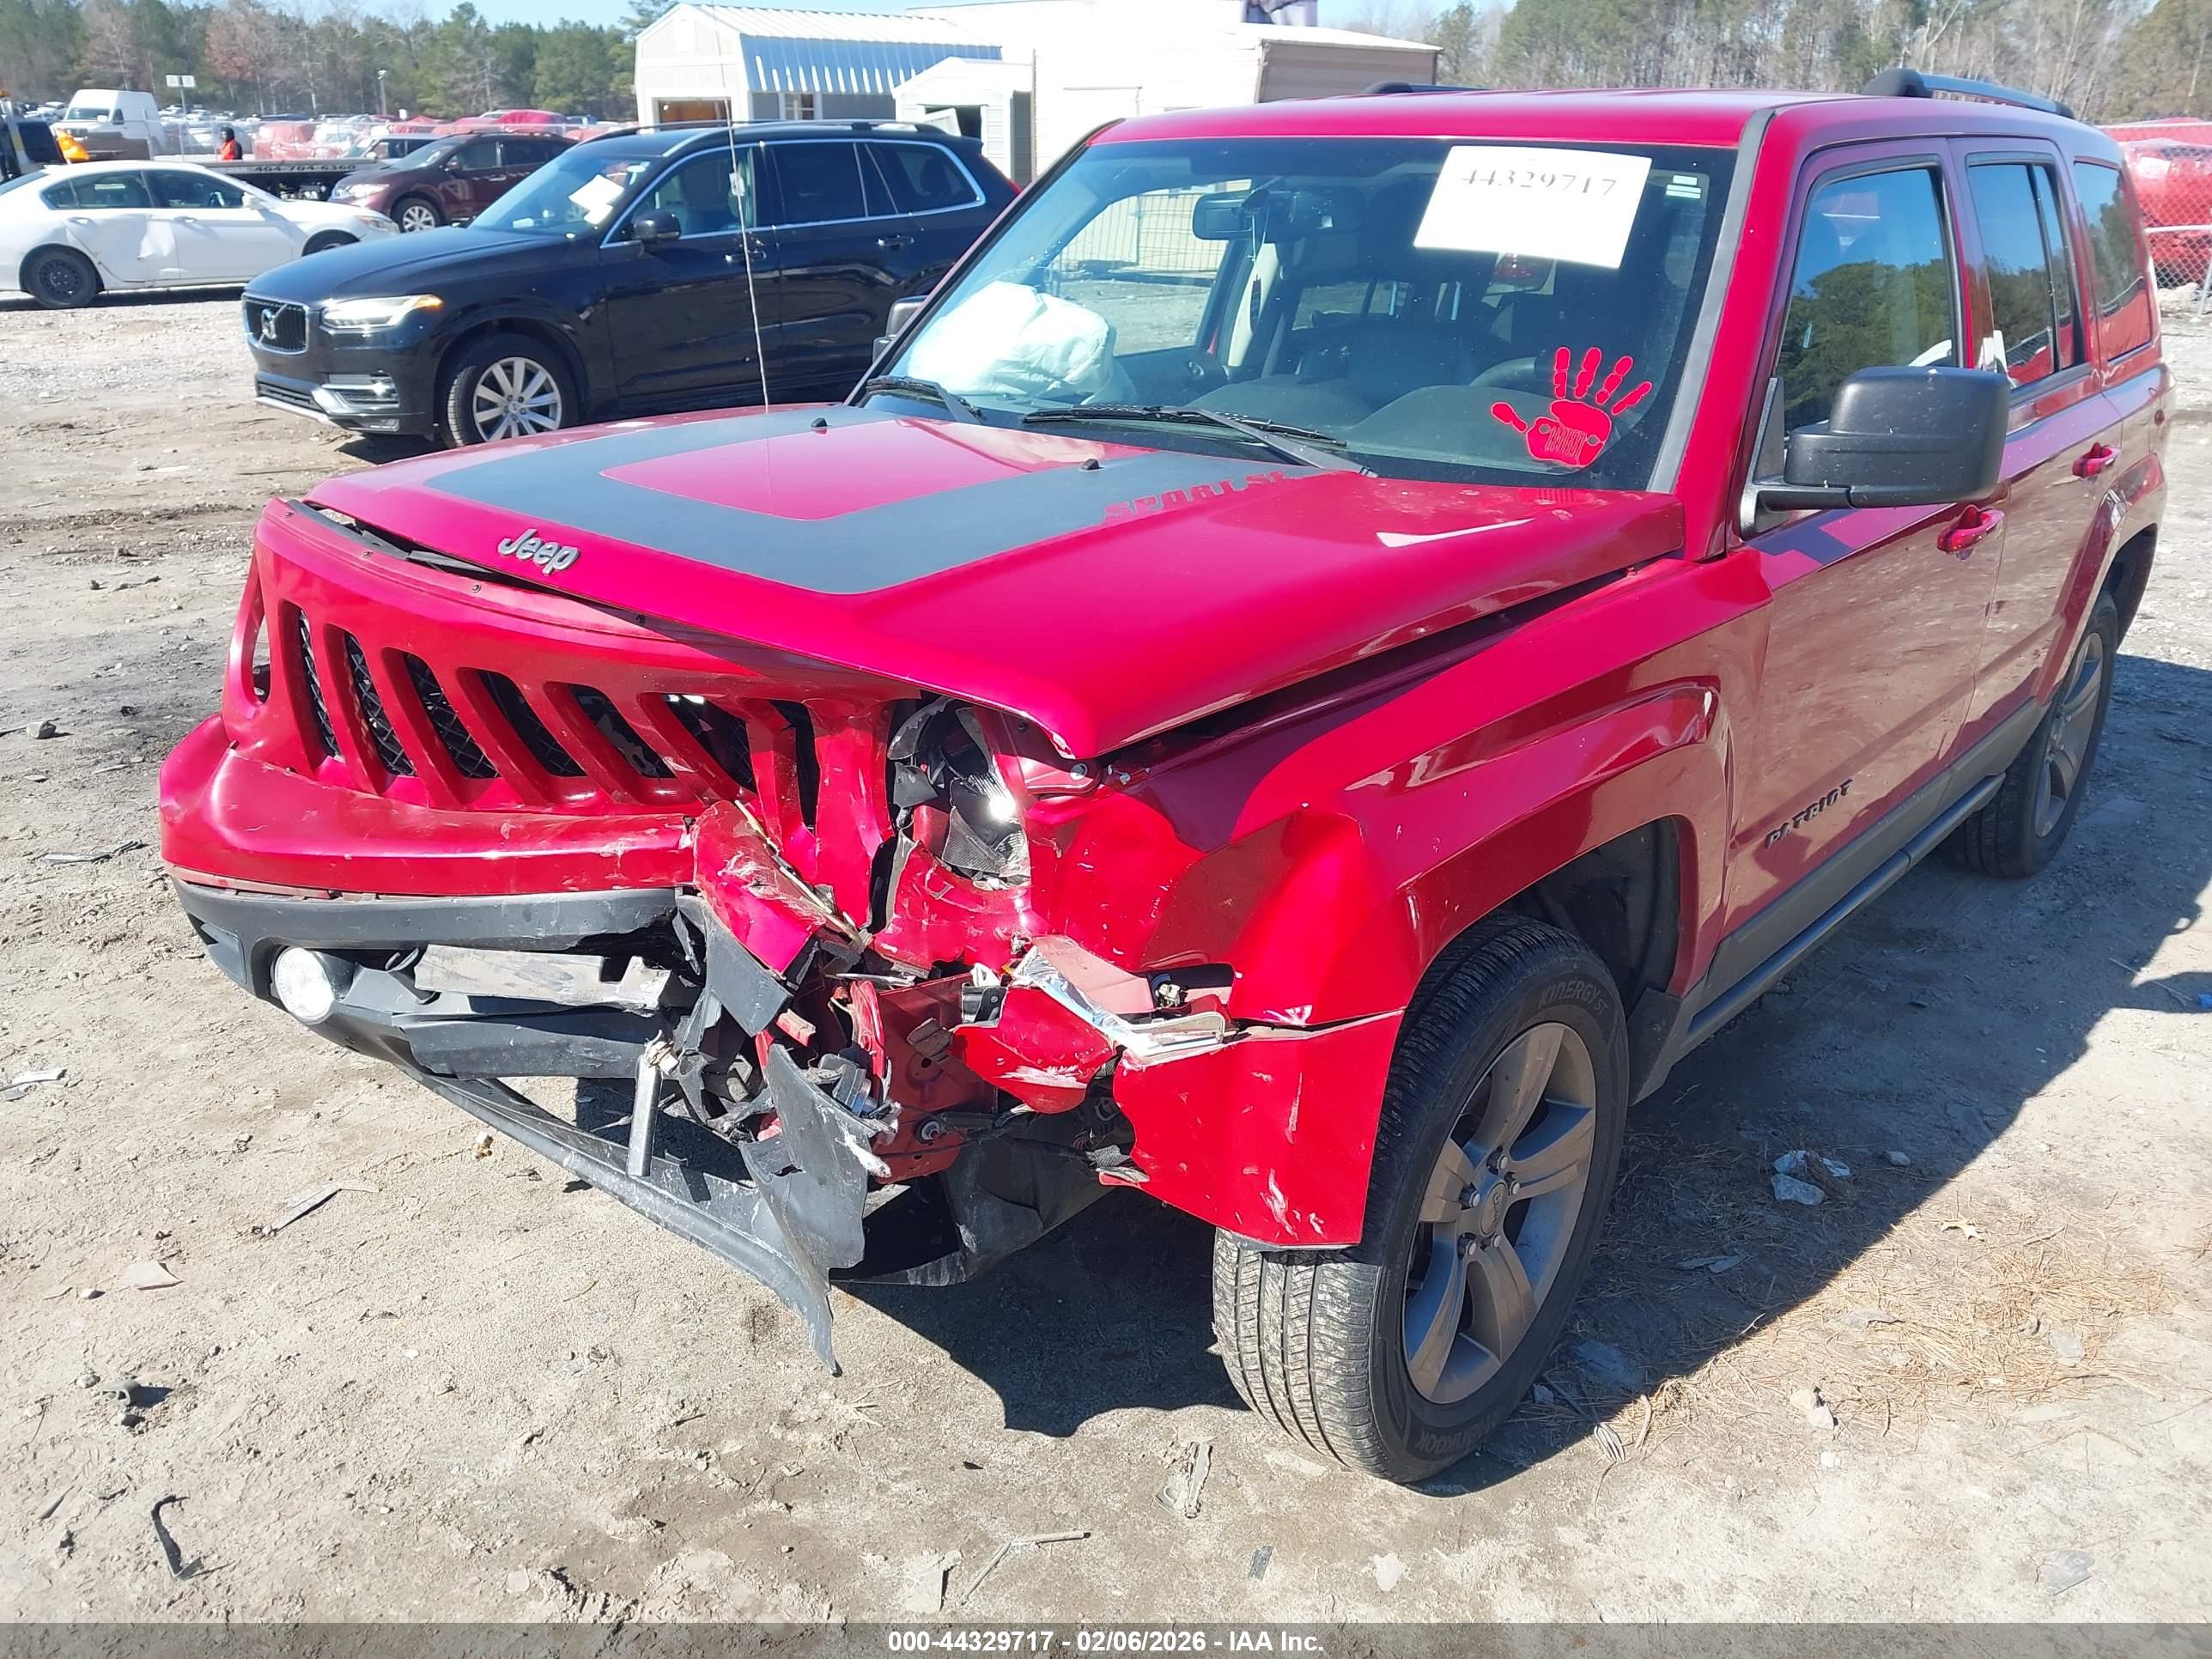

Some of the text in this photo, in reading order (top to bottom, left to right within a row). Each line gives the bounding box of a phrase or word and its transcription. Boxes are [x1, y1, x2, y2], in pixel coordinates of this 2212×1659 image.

[1461, 168, 1618, 197] 44329717
[498, 528, 580, 577] Jeep
[1765, 778, 1854, 849] PATRIOT
